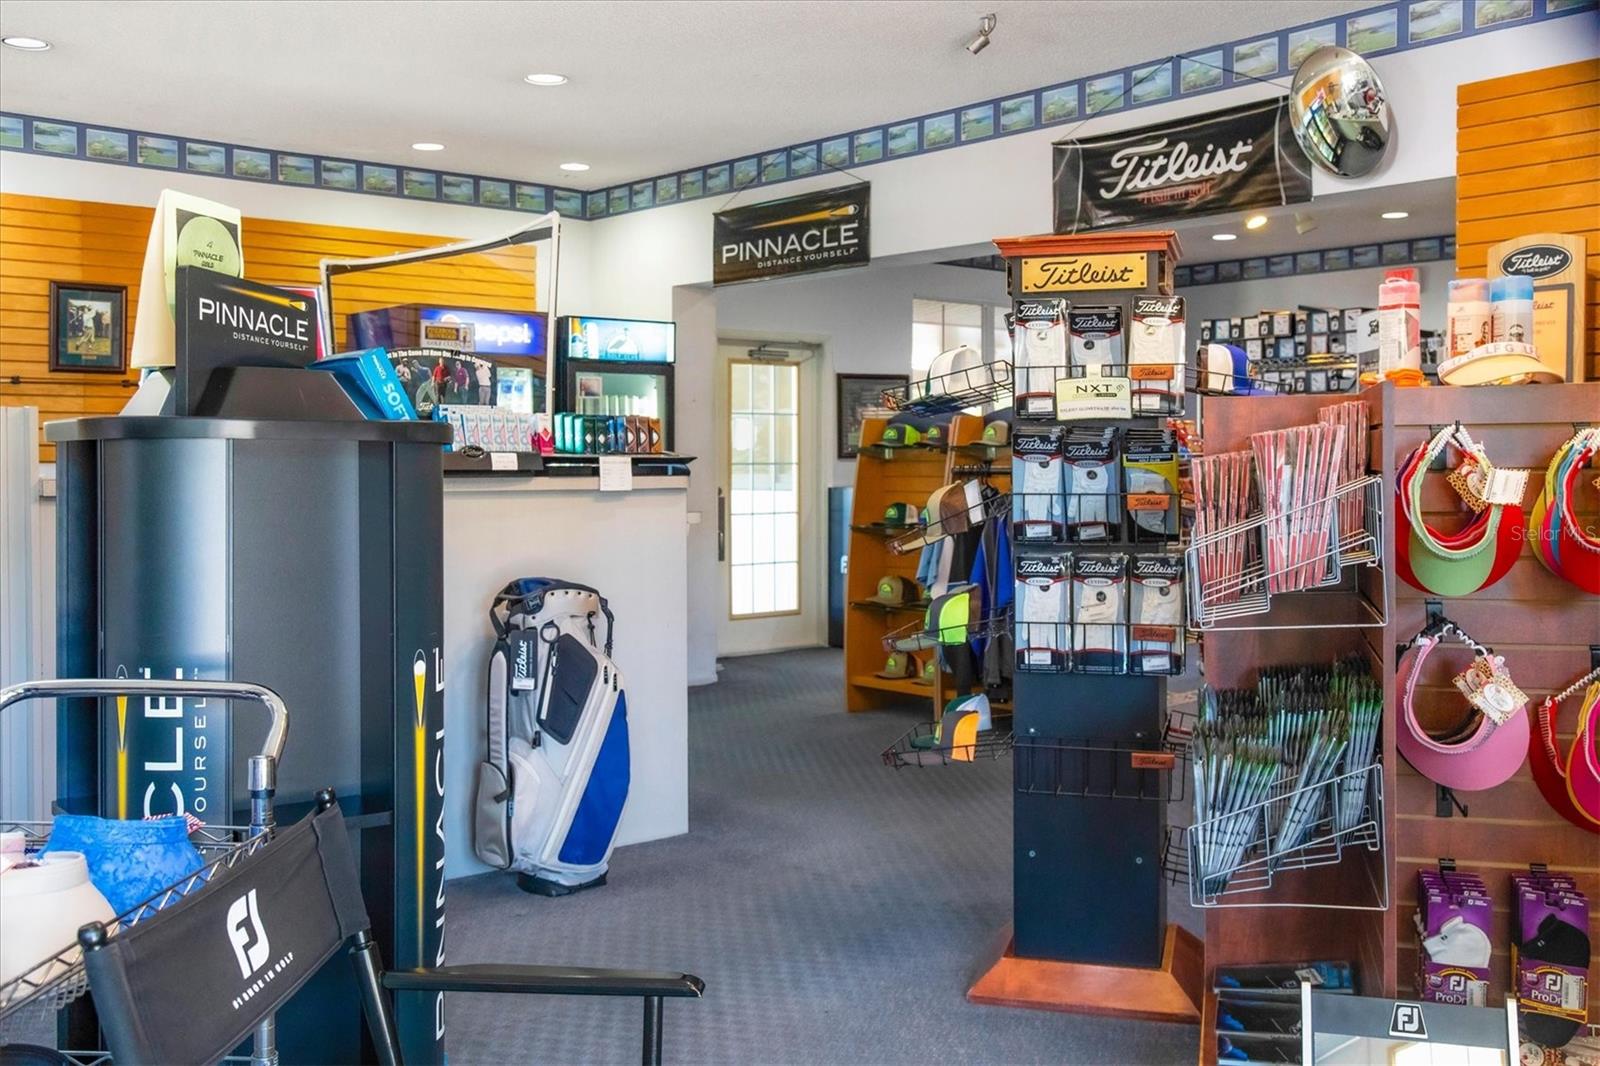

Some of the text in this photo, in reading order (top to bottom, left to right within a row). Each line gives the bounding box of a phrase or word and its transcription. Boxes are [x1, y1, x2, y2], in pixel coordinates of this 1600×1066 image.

[1100, 138, 1252, 199] Titleist
[722, 222, 859, 264] PINNACLE
[757, 248, 854, 269] DISTANCE YOURSELF
[1507, 252, 1564, 272] Titleist
[1033, 258, 1134, 289] Titleist
[1018, 303, 1060, 317] Titleist
[1135, 300, 1181, 314] Titleist
[199, 297, 309, 341] PINNACLE
[1073, 315, 1117, 329] Titleist
[233, 332, 307, 351] DISTANCE YOURSELF
[1076, 384, 1113, 394] NXT
[1015, 437, 1060, 450] Titleist
[1066, 444, 1110, 457] Titleist
[1018, 560, 1061, 574] Titleist
[1076, 560, 1121, 574] Titleist
[1133, 561, 1179, 575] Titleist
[515, 640, 527, 678] Titleist
[226, 888, 270, 980] FJ
[242, 979, 265, 1001] SHOE
[264, 969, 275, 982] IN
[274, 952, 294, 973] GOLF
[1449, 975, 1465, 991] FJ
[1545, 974, 1561, 991] FJ
[1435, 991, 1467, 1004] ProDr
[1531, 989, 1562, 1004] ProDr
[1397, 1007, 1419, 1031] FJ
